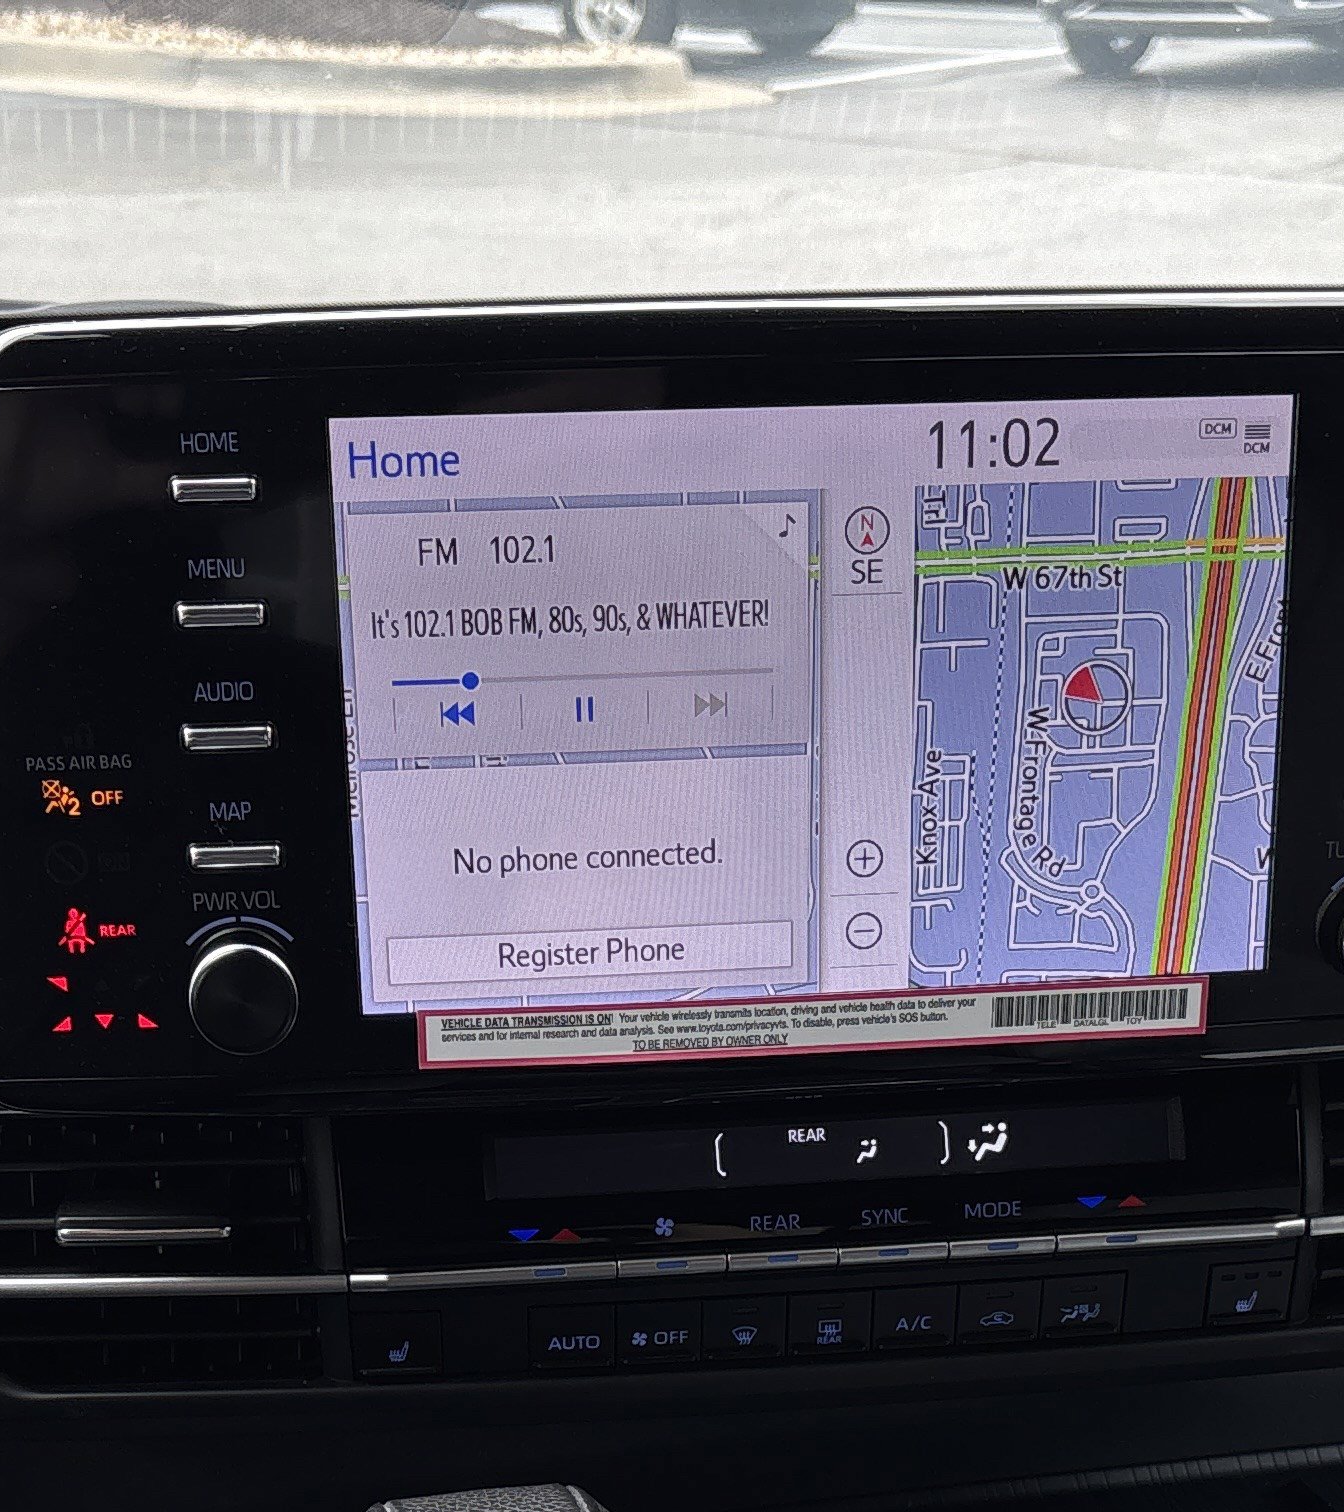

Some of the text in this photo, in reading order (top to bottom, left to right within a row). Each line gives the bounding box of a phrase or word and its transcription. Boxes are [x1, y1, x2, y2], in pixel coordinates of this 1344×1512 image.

[1204, 421, 1232, 436] DCM
[179, 431, 240, 455] HOME
[928, 417, 1061, 469] 11:02
[1243, 441, 1271, 455] DCM
[347, 439, 461, 480] Home
[860, 513, 876, 532] N
[417, 535, 556, 566] FM 102.1
[186, 557, 246, 580] MENU
[850, 559, 884, 584] SE
[1003, 563, 1124, 590] W 67th St
[370, 598, 770, 640] It's 102.1 BOB FM, 80s, 90s, & WHATEVER!
[1245, 661, 1270, 683] E
[193, 681, 255, 703] AUDIO
[25, 754, 133, 772] PASS AIR BAG
[91, 790, 124, 806] OFF
[1014, 707, 1066, 878] W Frontage Rd
[208, 801, 252, 822] MAP
[915, 748, 943, 866] Knox Ave
[453, 838, 725, 879] No phone connected.
[192, 890, 281, 912] PWR VOL
[99, 924, 137, 938] REAR
[498, 936, 686, 973] Register Phone
[441, 1016, 483, 1029] VEHICLE
[485, 1016, 509, 1028] DATA
[512, 1014, 583, 1027] TRANSMISSION
[619, 1012, 638, 1024] Your
[640, 1011, 670, 1022] vehicle
[791, 1005, 819, 1017] driving
[821, 1003, 837, 1014] and
[957, 997, 977, 1010] your
[898, 1013, 919, 1024] SOS
[647, 1039, 661, 1050] BE
[662, 1037, 710, 1049] REMOVED
[711, 1036, 724, 1048] BY
[726, 1034, 762, 1047] OWNER
[763, 1033, 789, 1045] ONLY
[787, 1127, 827, 1143] REAR
[861, 1207, 909, 1226] SYNC
[964, 1200, 1021, 1218] MODE
[749, 1213, 801, 1232] REAR
[895, 1313, 932, 1332] A/C
[548, 1335, 601, 1351] AUTO
[653, 1330, 689, 1346] OFF
[816, 1334, 843, 1345] REAR
